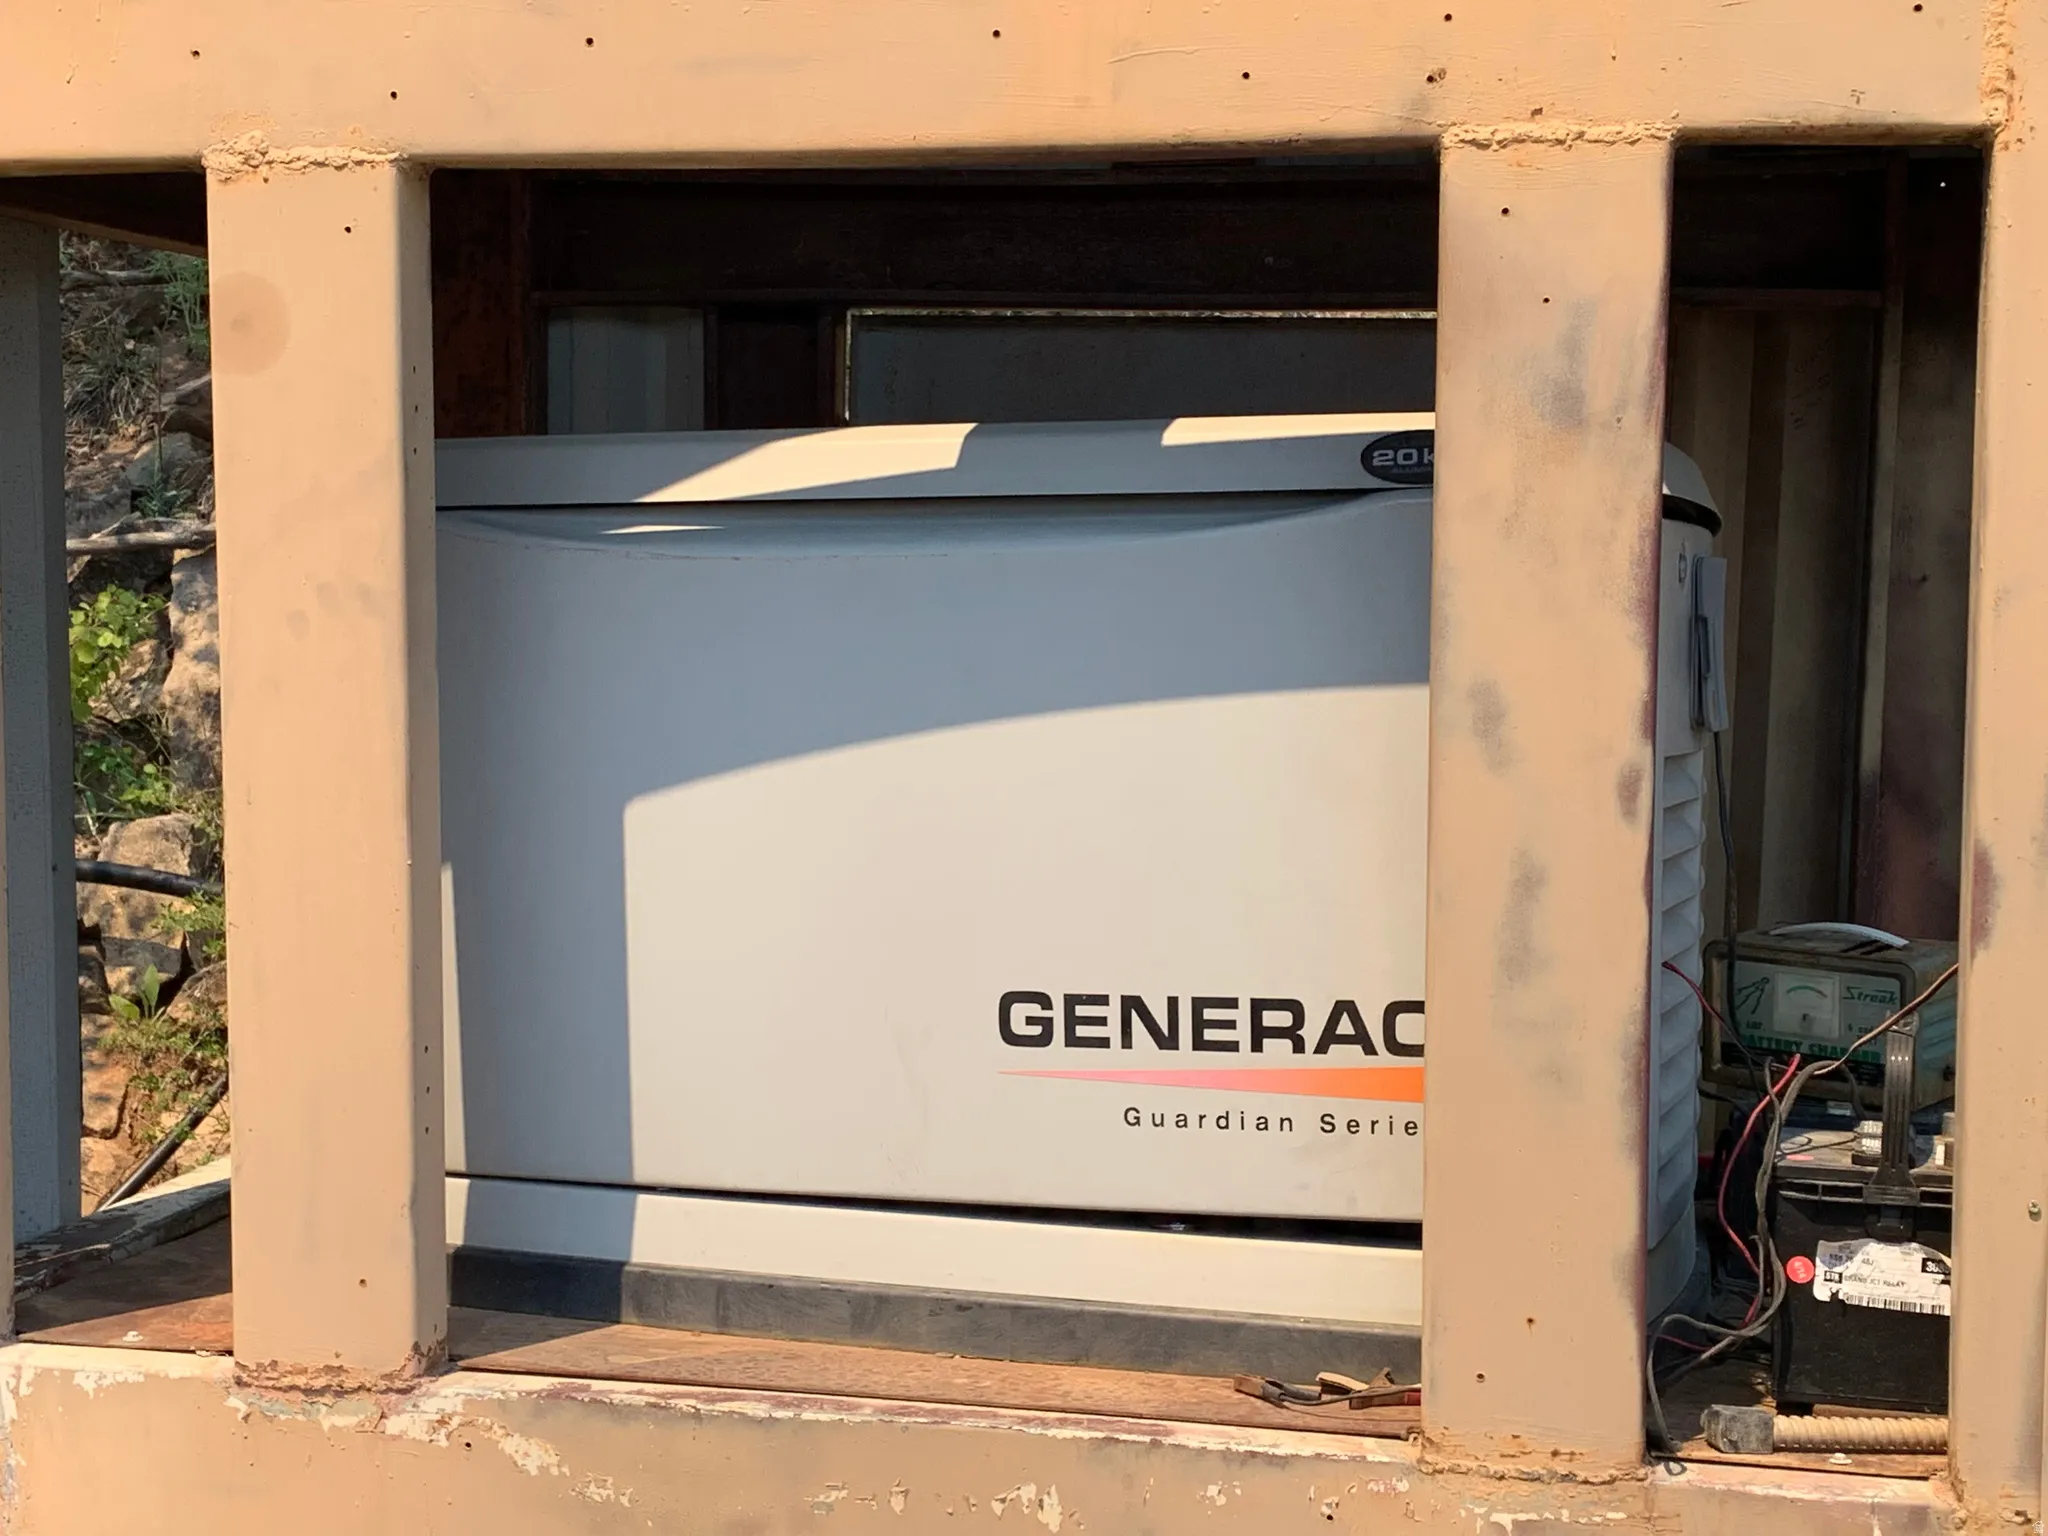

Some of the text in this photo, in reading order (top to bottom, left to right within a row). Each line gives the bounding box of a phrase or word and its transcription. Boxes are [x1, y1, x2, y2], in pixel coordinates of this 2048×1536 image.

[1843, 986, 1898, 1005] Streak
[998, 990, 1425, 1058] GENERAC
[1808, 1042, 1882, 1064] CHARER
[1123, 1106, 1294, 1131] Guardian
